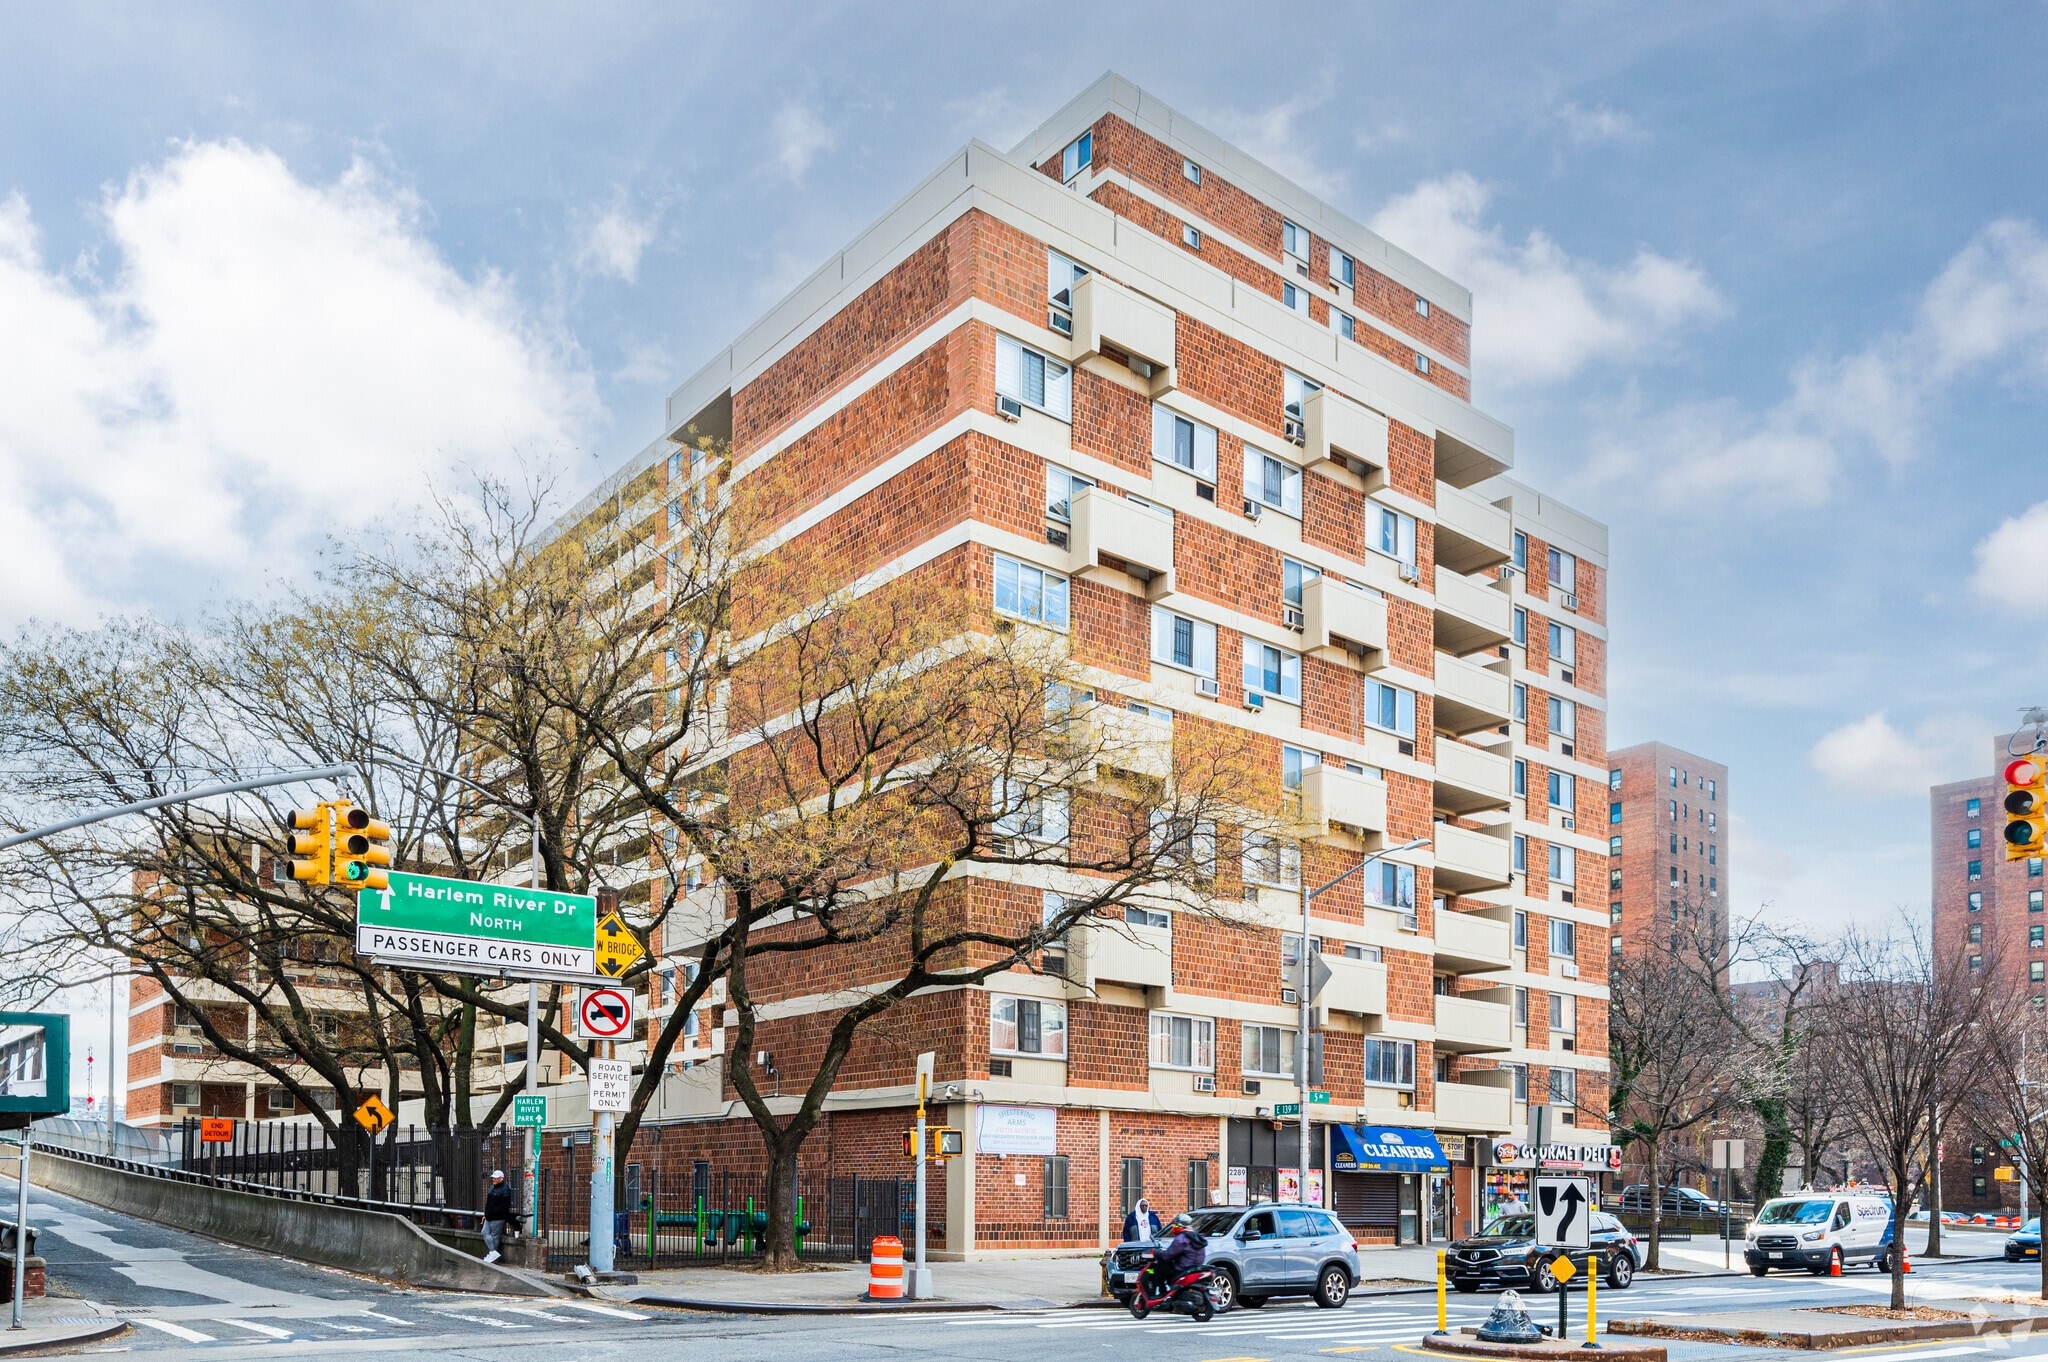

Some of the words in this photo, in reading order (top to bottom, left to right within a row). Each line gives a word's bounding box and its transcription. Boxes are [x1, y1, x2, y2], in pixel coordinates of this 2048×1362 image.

[408, 882, 483, 906] Harlem
[493, 893, 546, 912] River
[554, 901, 577, 916] Dr
[470, 912, 522, 932] NORTH
[373, 934, 478, 958] PASSENGER
[488, 945, 532, 962] CARS
[541, 951, 581, 967] ONLY
[608, 942, 636, 956] BRIDGE
[598, 1064, 622, 1072] ROAD
[592, 1072, 628, 1082] SERVICE
[594, 1090, 626, 1098] PERMIT
[1314, 1092, 1318, 1102] 5
[598, 1100, 621, 1108] ONLY
[1276, 1106, 1280, 1114] E
[1282, 1104, 1292, 1114] 139
[998, 1108, 1035, 1120] SHELTERING
[1363, 1144, 1434, 1160] CLEANERS
[1521, 1144, 1580, 1161] GOURMET
[1584, 1146, 1607, 1162] DELI
[1856, 1204, 1884, 1219] Spectrum
